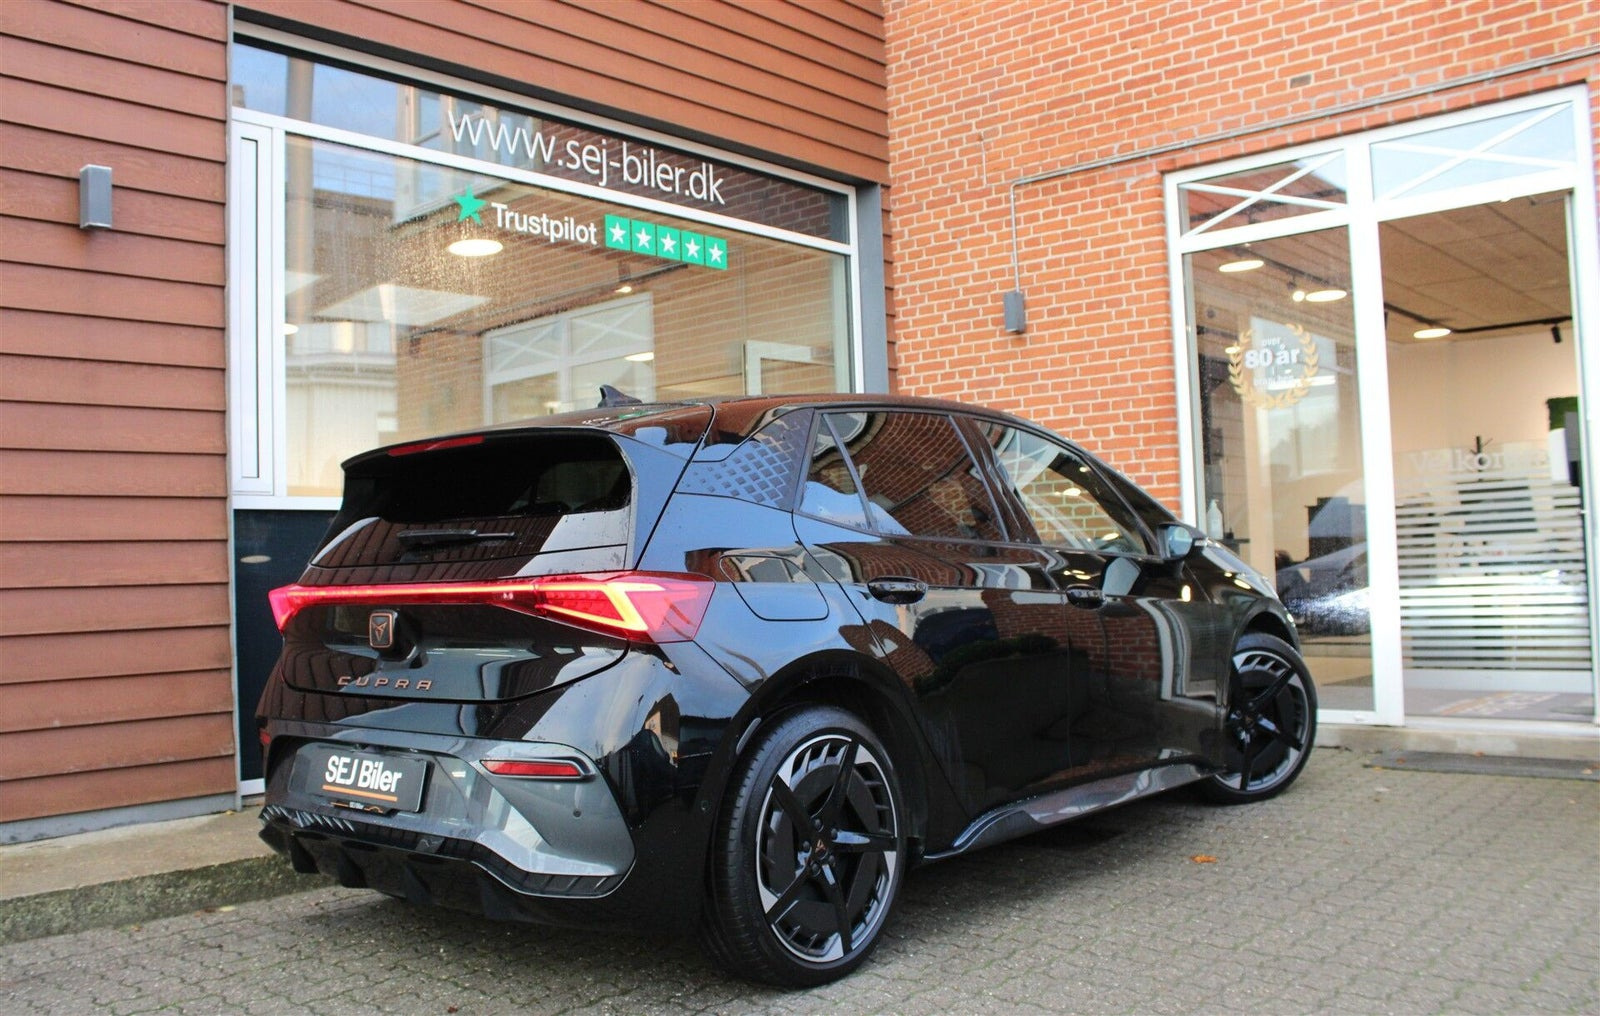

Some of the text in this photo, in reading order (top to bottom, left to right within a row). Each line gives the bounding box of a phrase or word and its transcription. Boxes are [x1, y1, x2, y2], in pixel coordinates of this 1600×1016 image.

[448, 110, 725, 205] www.sej-biler.dk
[491, 202, 598, 246] Trustpilot
[1245, 348, 1273, 369] 80
[337, 676, 433, 691] CUPRA
[325, 755, 402, 793] SEJ Biler
